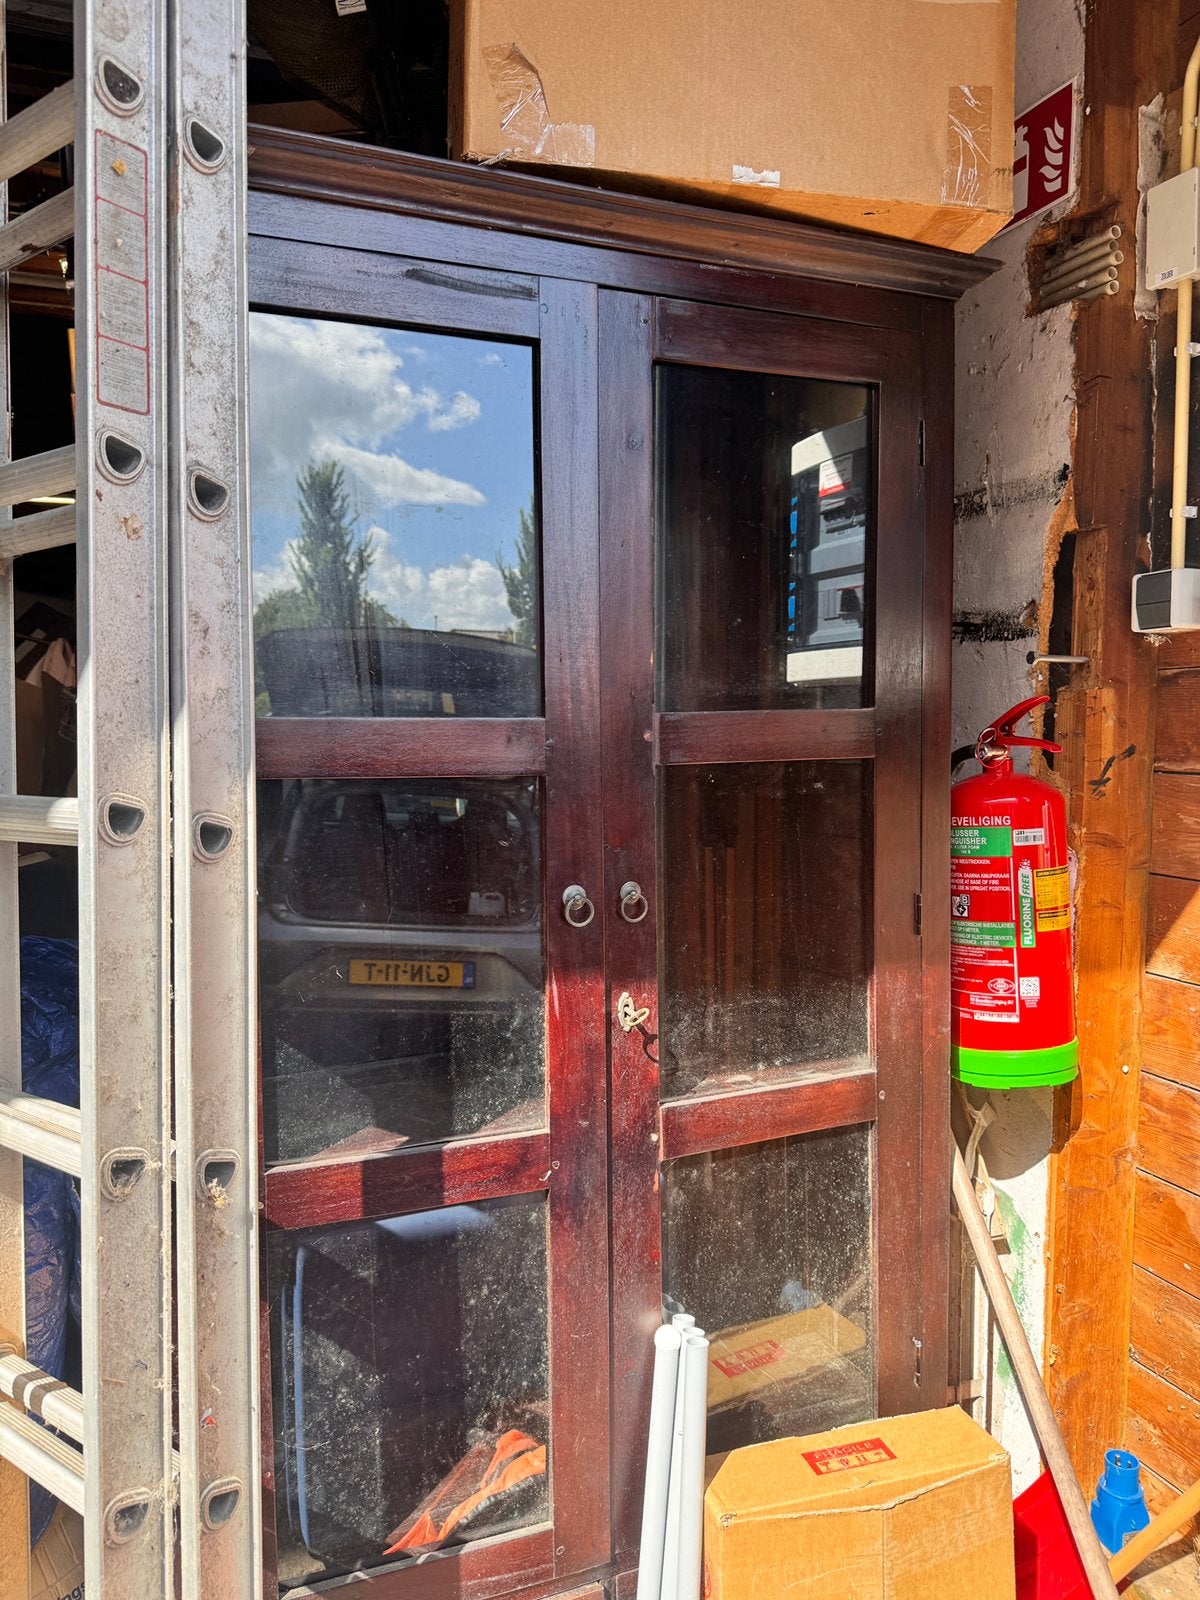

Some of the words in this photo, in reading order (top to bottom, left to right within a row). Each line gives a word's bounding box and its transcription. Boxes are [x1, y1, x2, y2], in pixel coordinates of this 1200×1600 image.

[1021, 873, 1030, 895] FREE
[1022, 898, 1033, 945] FLUORINE
[813, 1441, 874, 1459] FRAGILE
